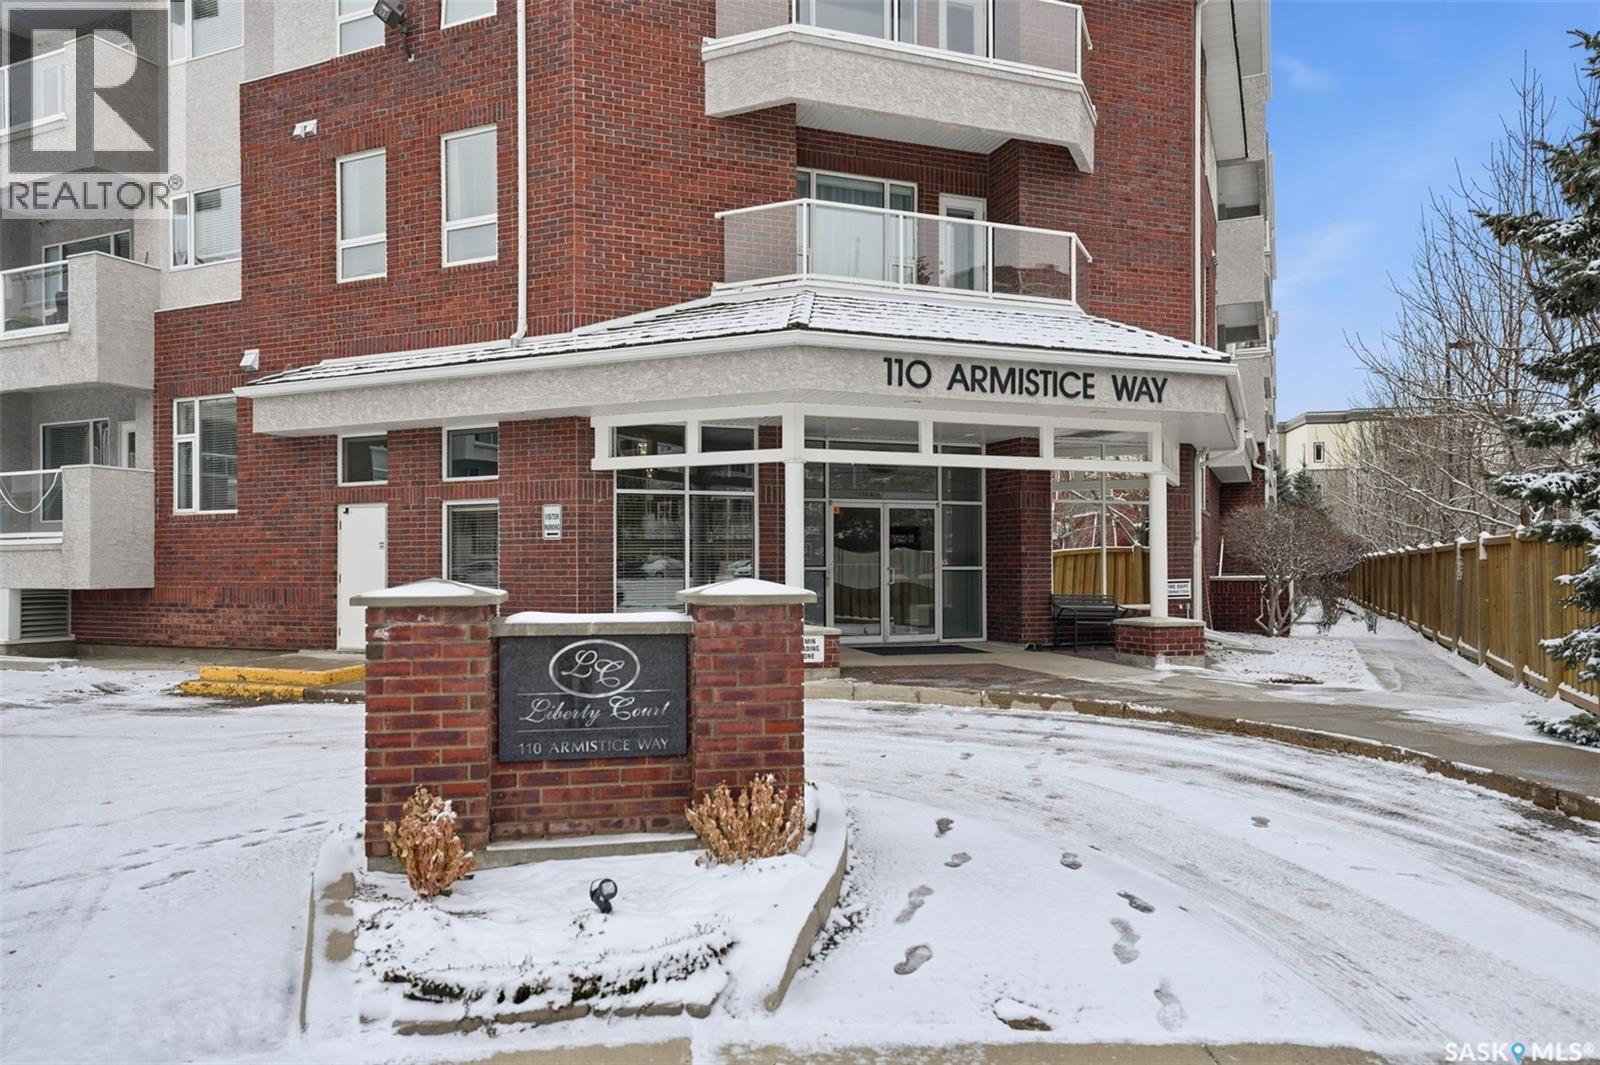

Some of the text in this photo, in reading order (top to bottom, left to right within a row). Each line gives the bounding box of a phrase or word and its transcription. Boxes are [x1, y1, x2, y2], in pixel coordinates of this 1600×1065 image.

[883, 357, 1169, 403] 110 ARMISTICE WAY
[519, 695, 671, 727] Liberty Court
[518, 737, 669, 755] 110 ARMISTICE WAY
